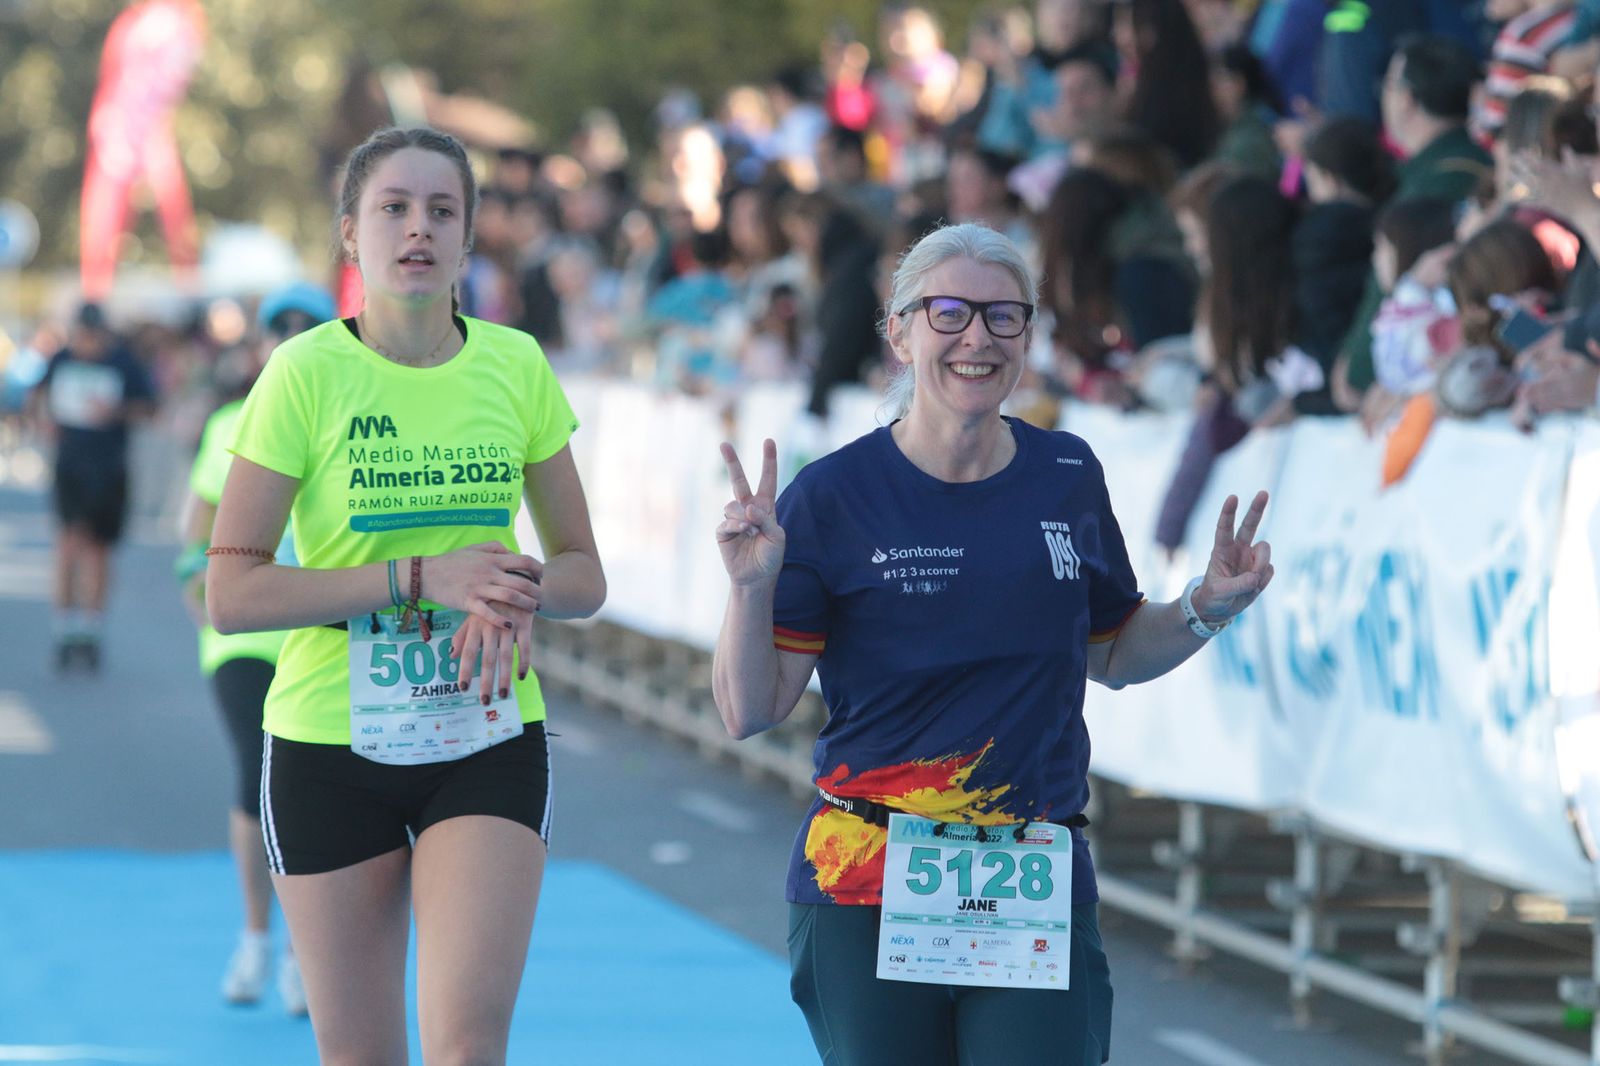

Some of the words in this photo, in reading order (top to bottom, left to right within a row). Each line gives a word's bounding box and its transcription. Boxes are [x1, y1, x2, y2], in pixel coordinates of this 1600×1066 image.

[349, 447, 413, 464] Medio
[423, 443, 510, 460] Maratón
[349, 465, 445, 489] Almería
[349, 497, 403, 510] RAMÓN
[409, 494, 443, 506] RUIZ
[449, 489, 512, 505] ANDÚJAR
[1040, 521, 1070, 532] RUTA
[889, 546, 965, 561] Santander
[411, 682, 461, 697] ZAHIRA
[905, 847, 1054, 901] 5128
[957, 898, 998, 912] JANE
[891, 936, 915, 946] NEXA
[932, 936, 952, 946] CDX
